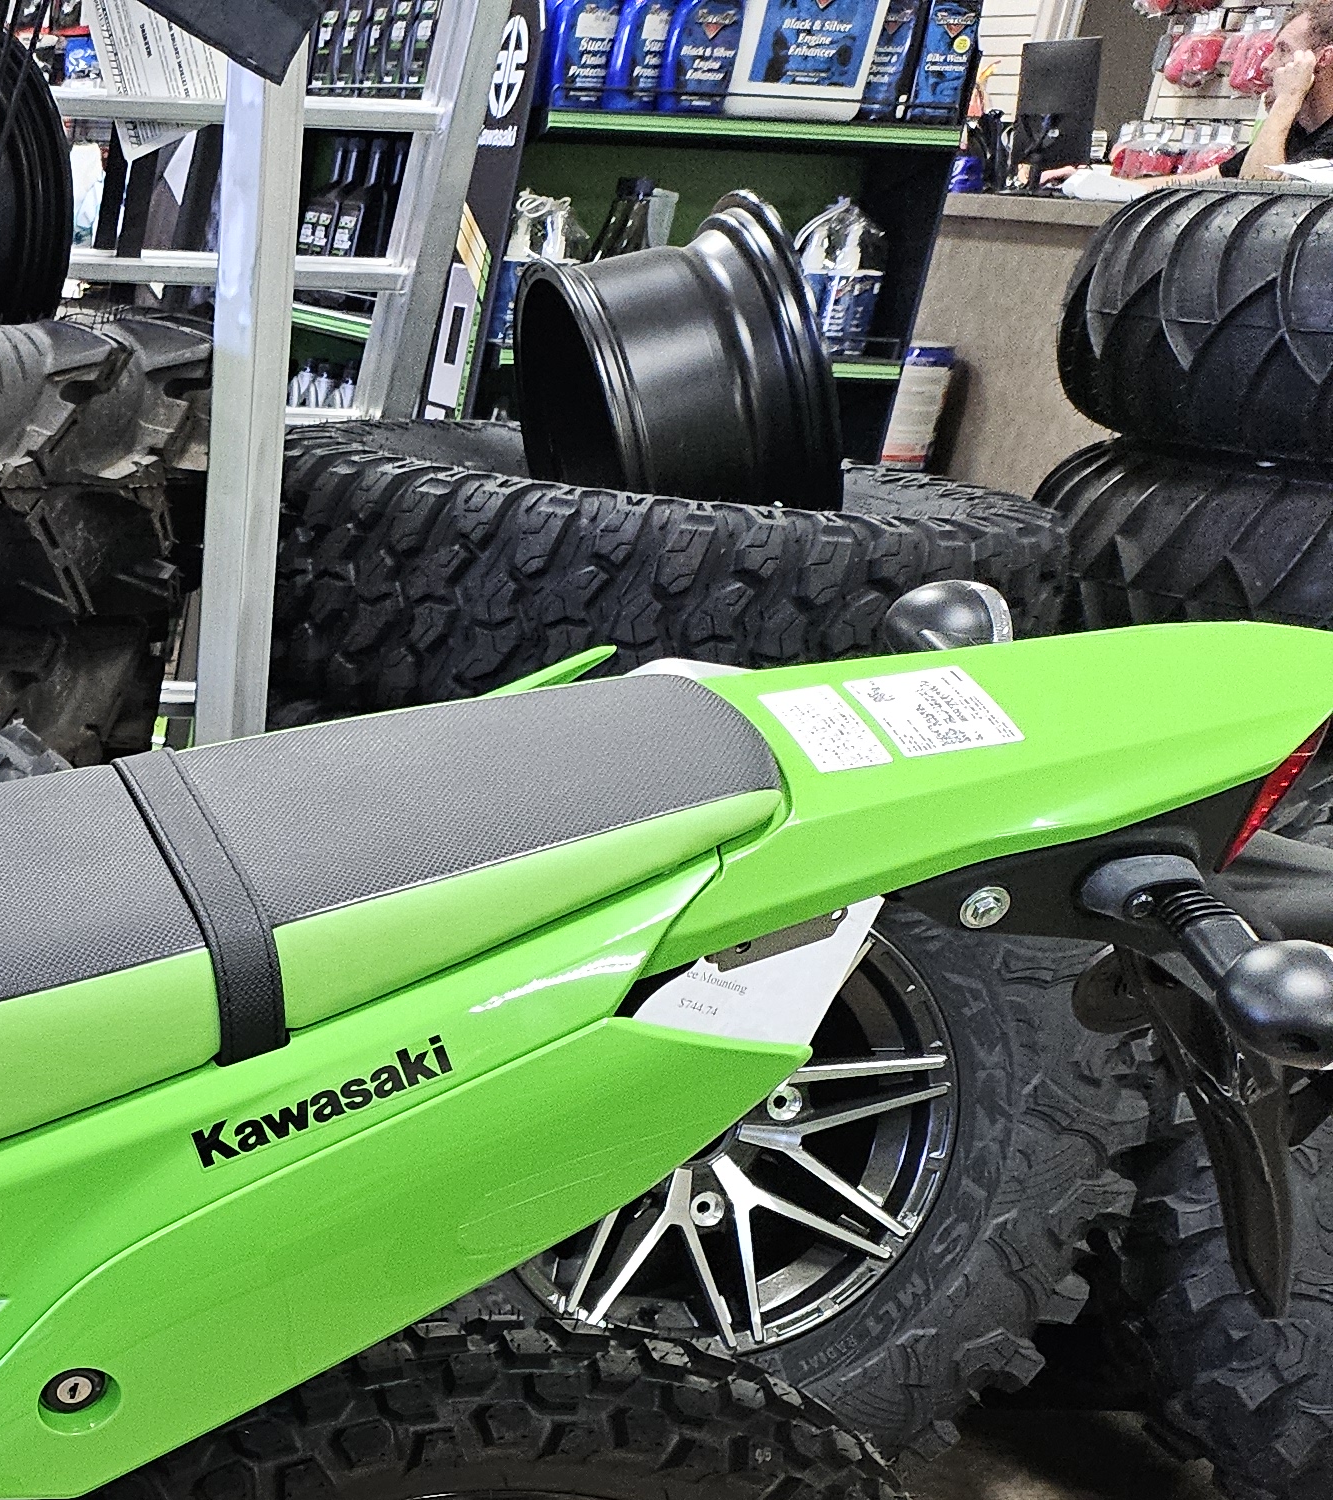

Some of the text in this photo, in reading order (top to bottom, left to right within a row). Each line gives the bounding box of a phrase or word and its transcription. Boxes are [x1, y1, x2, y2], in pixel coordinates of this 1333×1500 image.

[783, 17, 852, 32] Black & Silver
[797, 33, 831, 45] Engine
[788, 45, 836, 58] Enhancer
[701, 971, 748, 996] Mounting
[678, 998, 719, 1016] $744.74
[191, 1035, 453, 1169] Kawasaki
